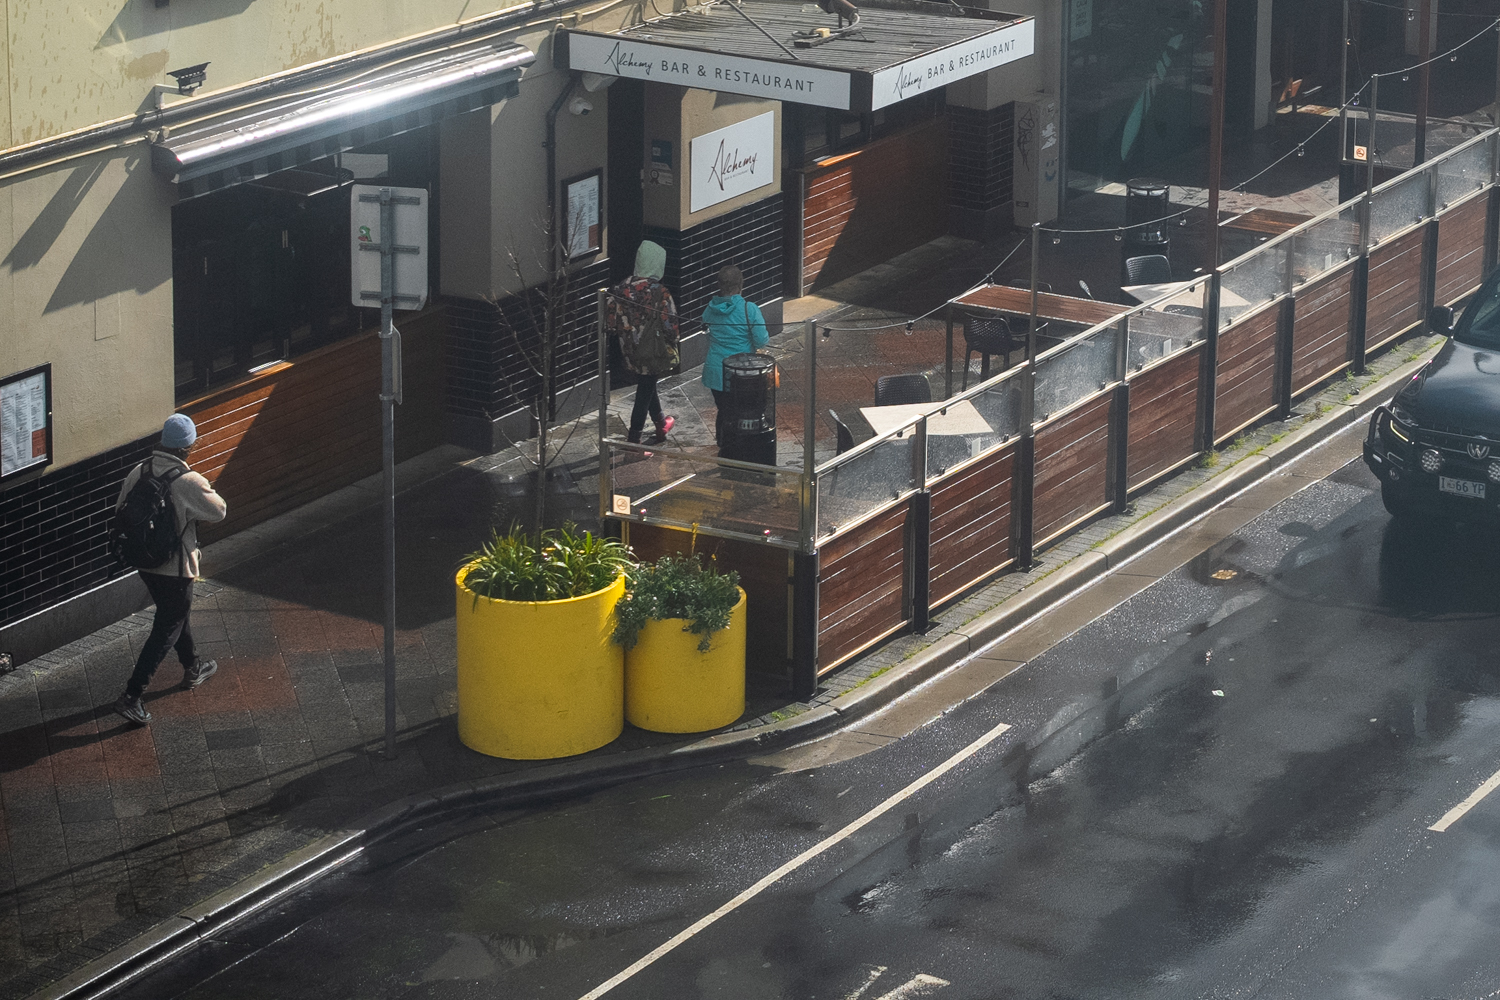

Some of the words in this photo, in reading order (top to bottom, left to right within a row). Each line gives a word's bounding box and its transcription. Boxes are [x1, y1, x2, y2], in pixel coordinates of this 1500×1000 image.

[604, 41, 653, 76] Alchemy
[661, 59, 690, 75] BAR
[697, 64, 707, 77] &
[714, 67, 815, 93] RESTAURANT
[893, 65, 924, 100] Alchemy
[927, 63, 945, 80] BAR
[948, 60, 955, 72] &
[958, 39, 1016, 69] RESTAURANT
[707, 138, 758, 191] Alchemy
